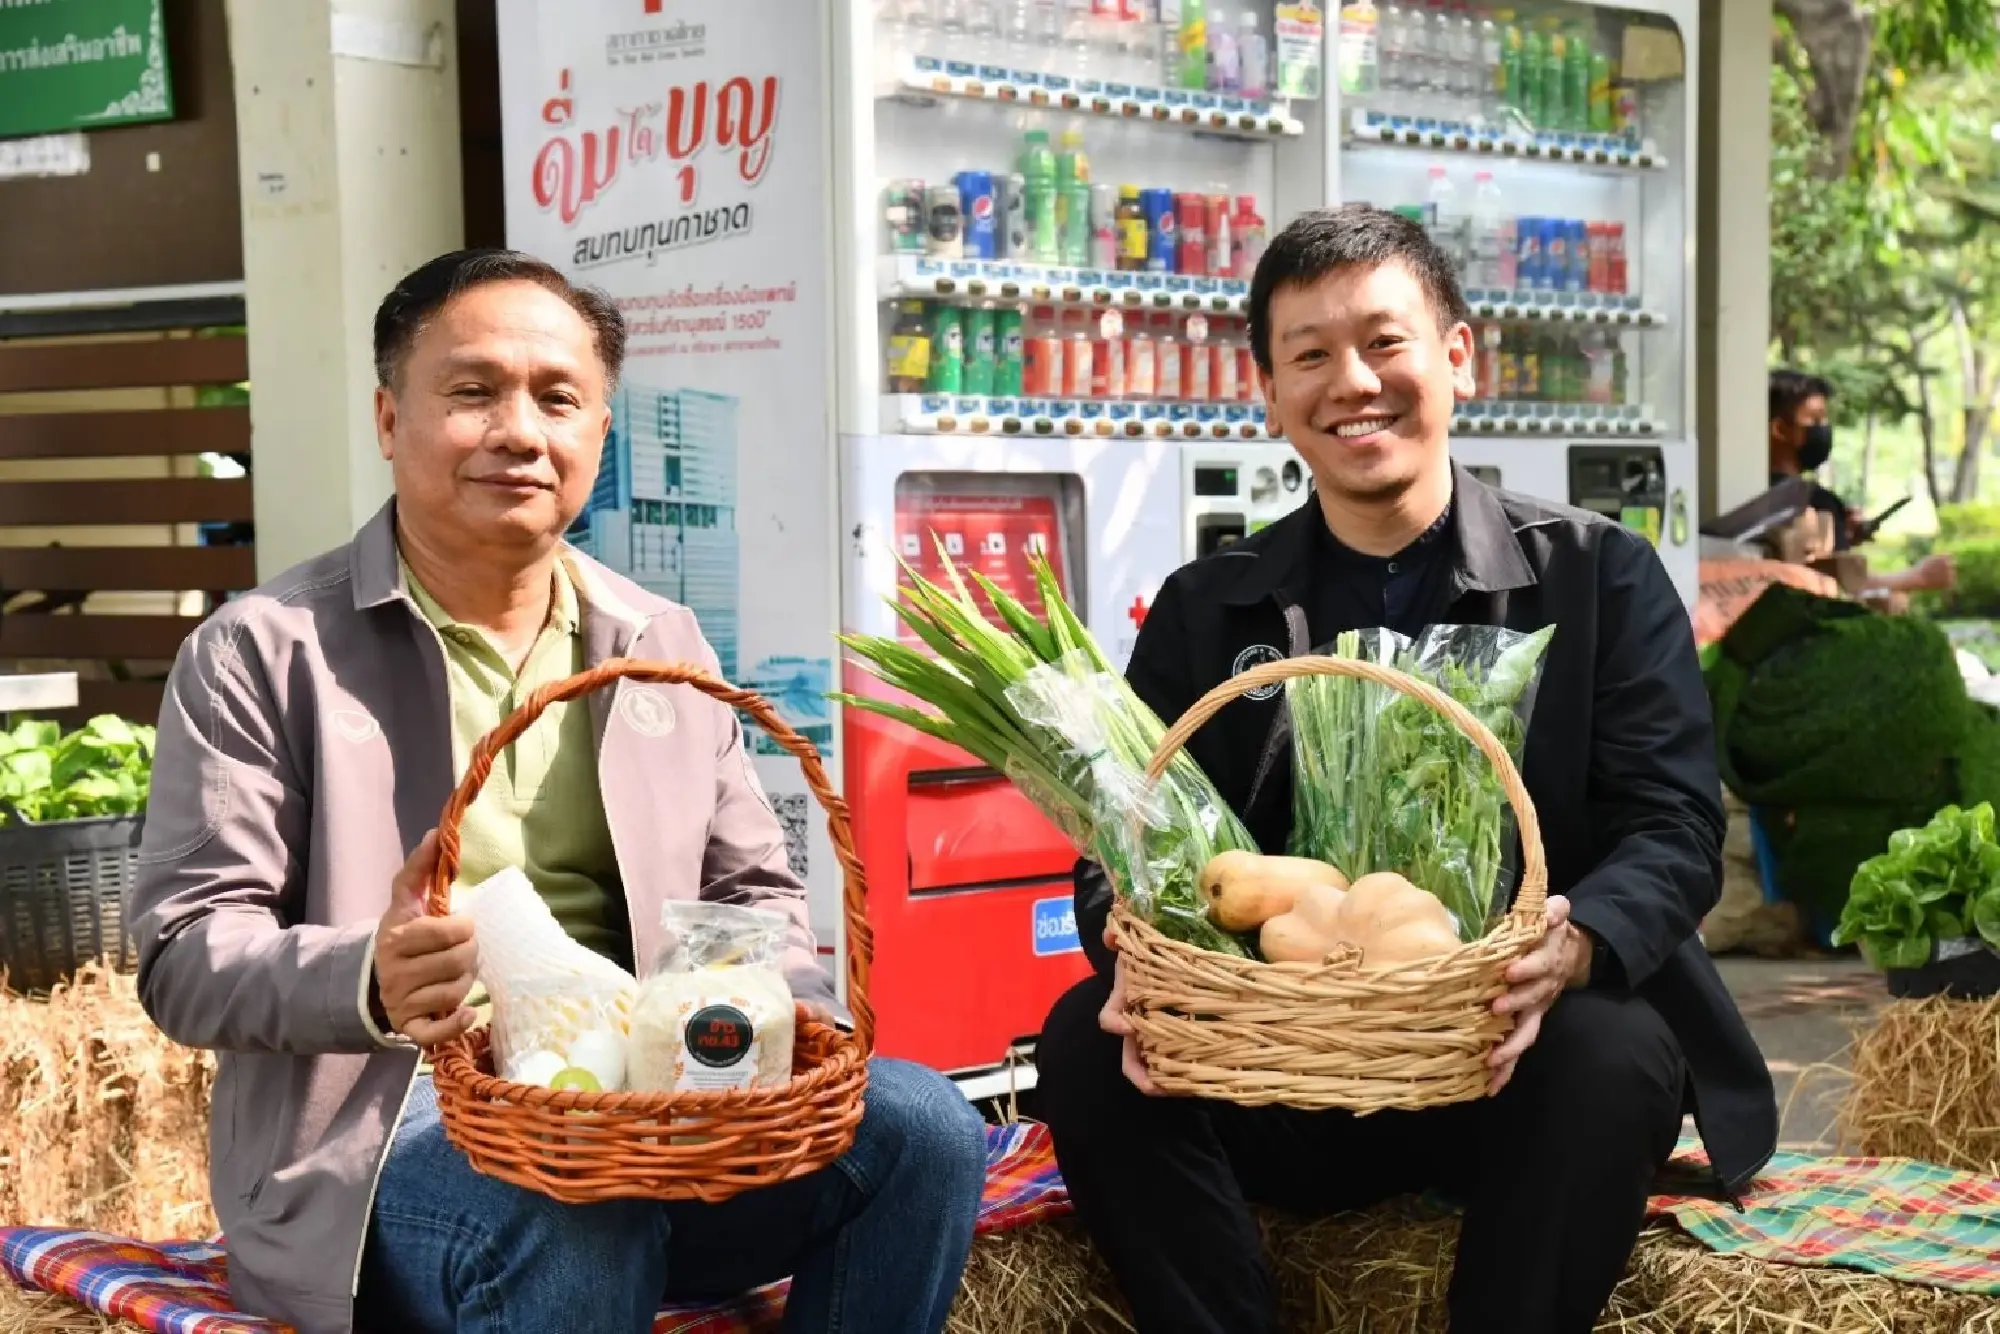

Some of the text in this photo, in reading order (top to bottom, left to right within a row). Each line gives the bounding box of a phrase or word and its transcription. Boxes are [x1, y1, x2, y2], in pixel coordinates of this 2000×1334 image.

[573, 202, 750, 264] สมทบทุนกาชาด
